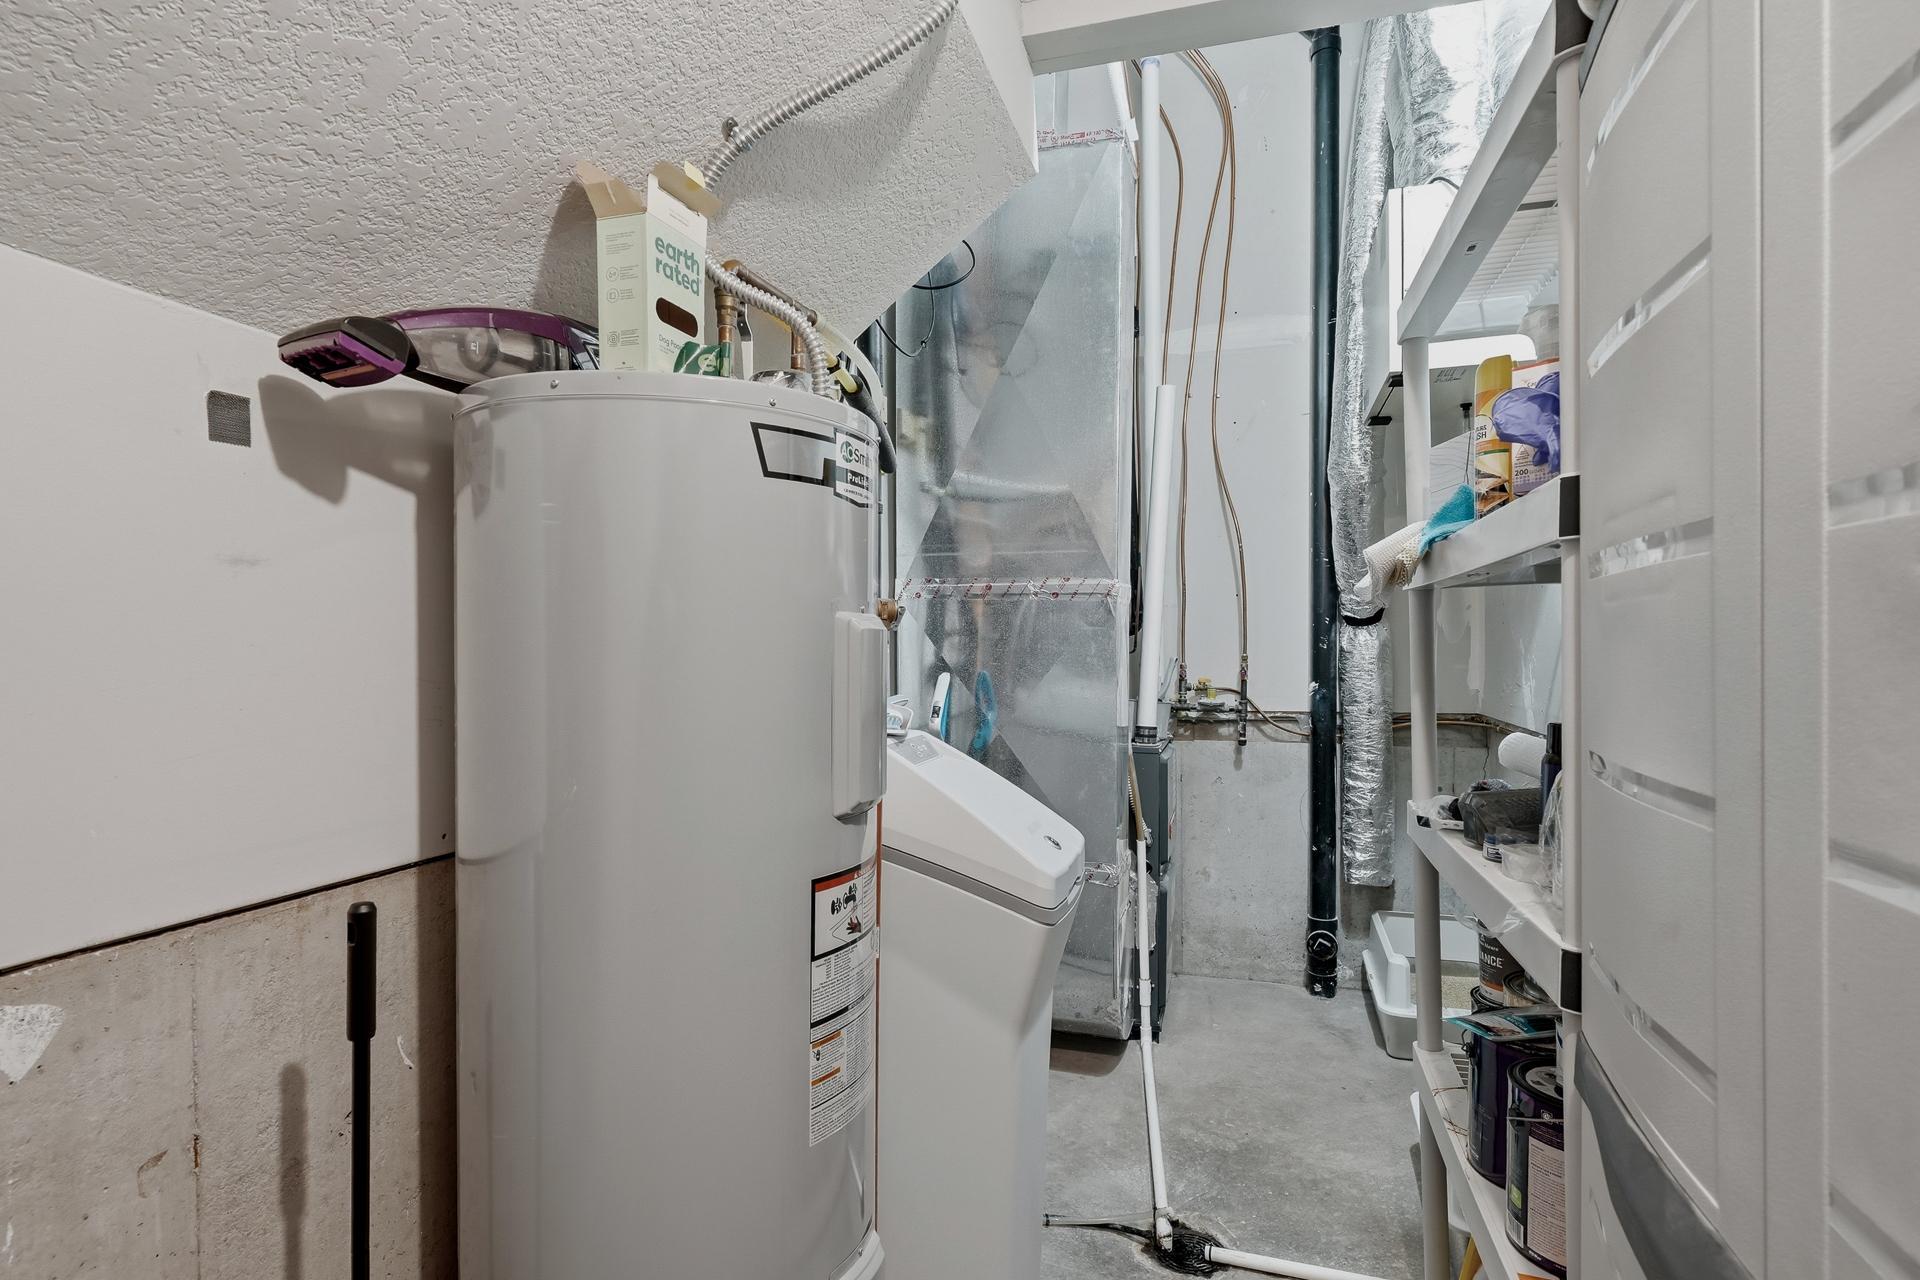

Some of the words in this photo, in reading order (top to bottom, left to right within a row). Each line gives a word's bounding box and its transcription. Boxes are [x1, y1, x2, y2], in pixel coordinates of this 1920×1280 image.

[655, 236, 700, 276] earth
[655, 257, 700, 297] rated
[1514, 467, 1529, 477] 200
